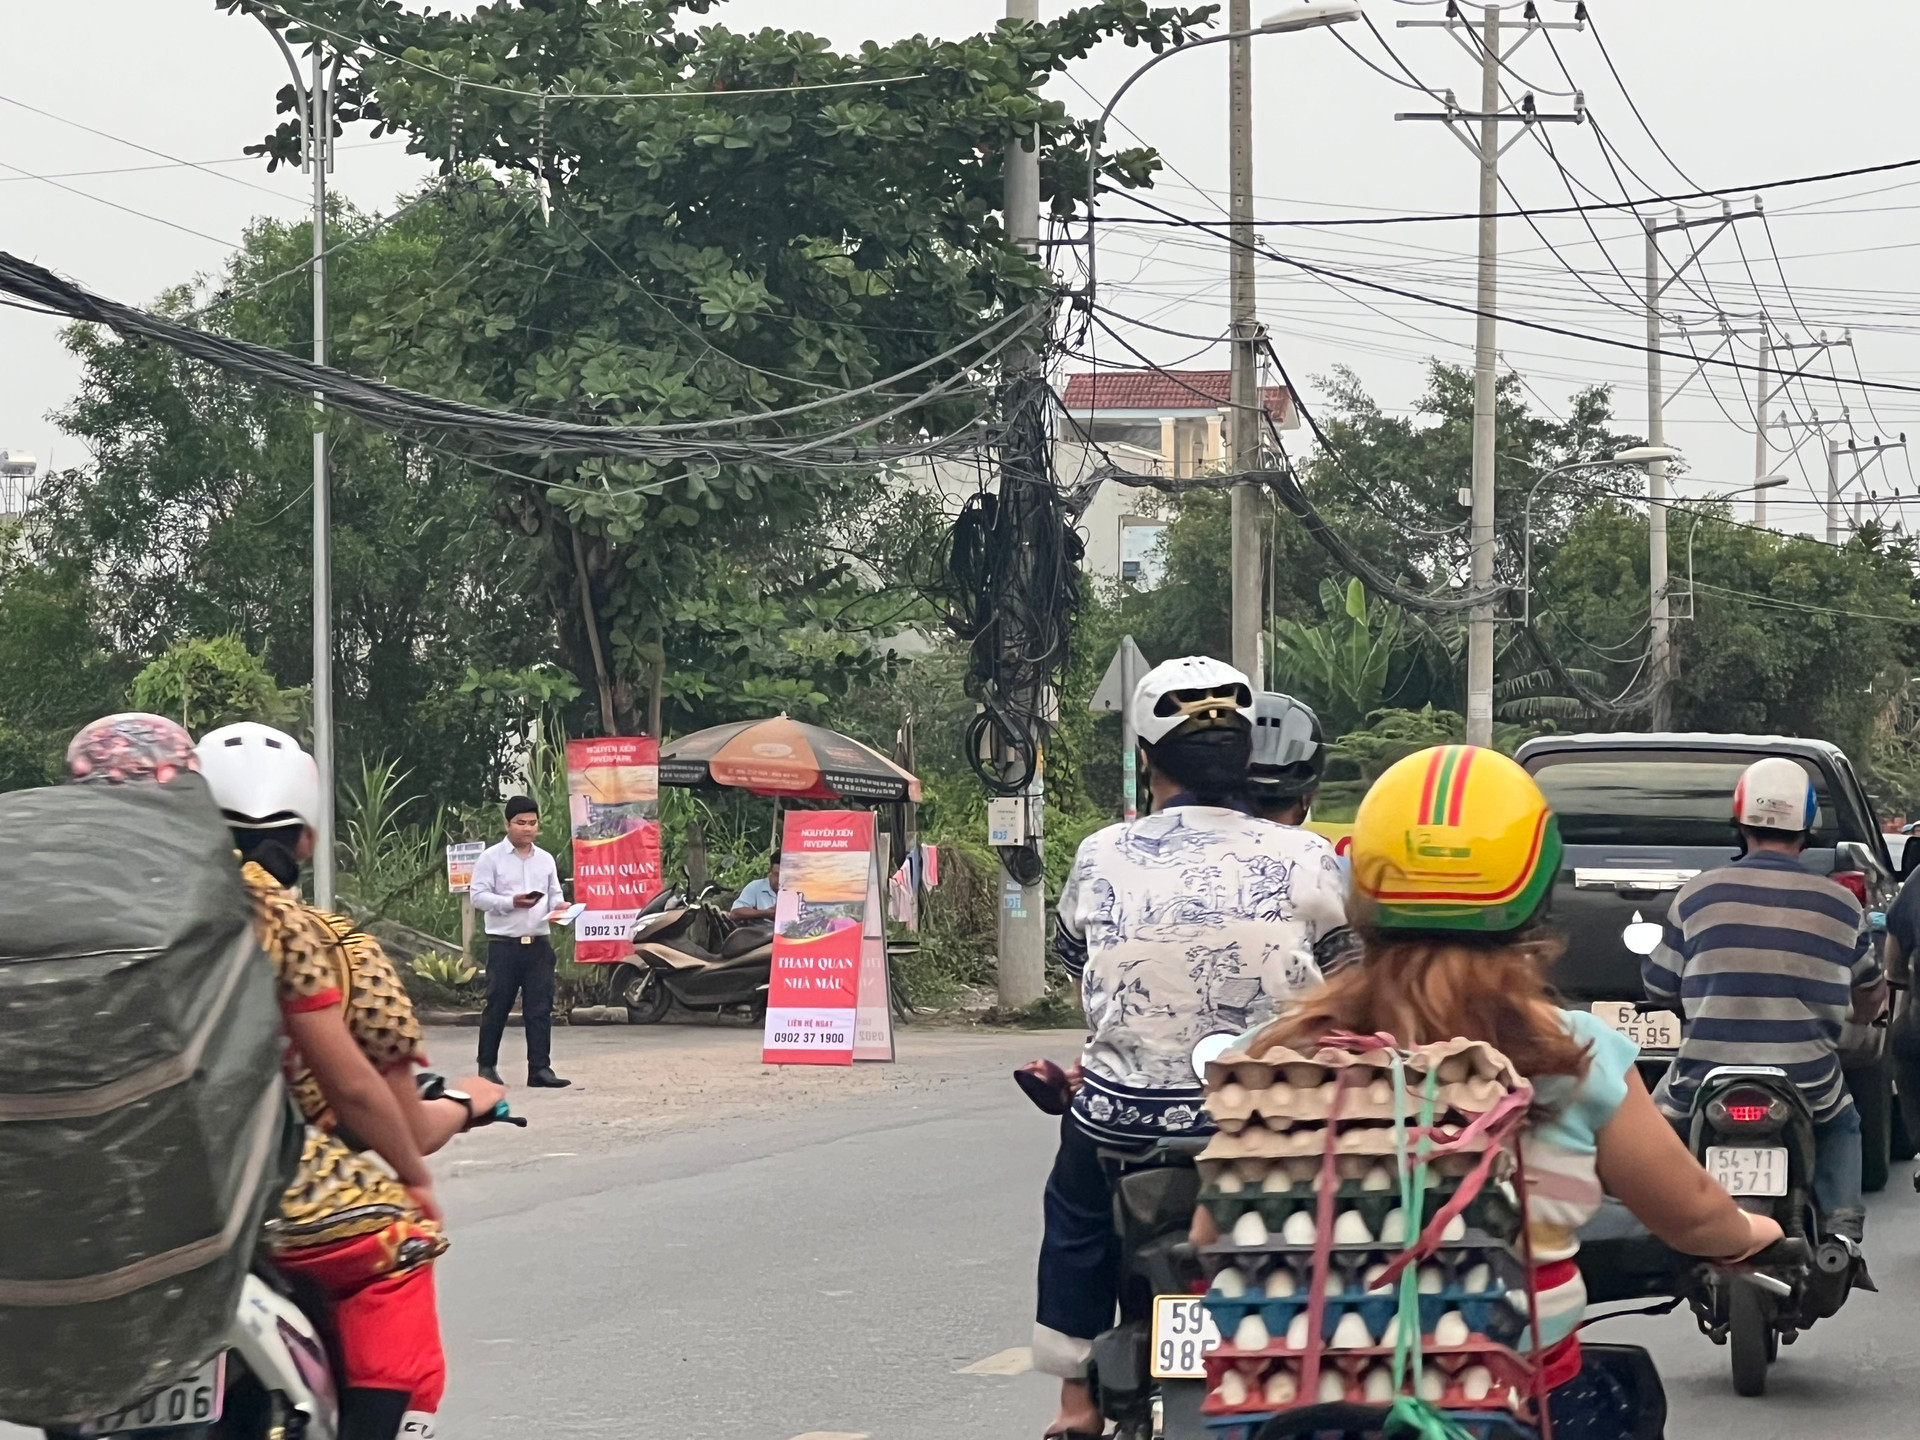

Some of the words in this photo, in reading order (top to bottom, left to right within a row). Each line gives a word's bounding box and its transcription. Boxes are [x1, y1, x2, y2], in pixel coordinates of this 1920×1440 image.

[803, 839, 848, 848] RIVERPARK
[580, 864, 615, 876] THAM
[619, 862, 656, 877] QUAN
[587, 880, 615, 896] NHÀ
[584, 925, 610, 936] 0902
[613, 925, 626, 936] 37
[778, 957, 814, 969] THAM
[817, 957, 853, 971] QUAN
[784, 975, 810, 989] NHÀ
[815, 1019, 833, 1028] NGAY
[774, 1032, 800, 1043] 0902
[803, 1032, 816, 1043] 37
[820, 1033, 844, 1043] 1900
[1615, 1026, 1671, 1045] 5.95
